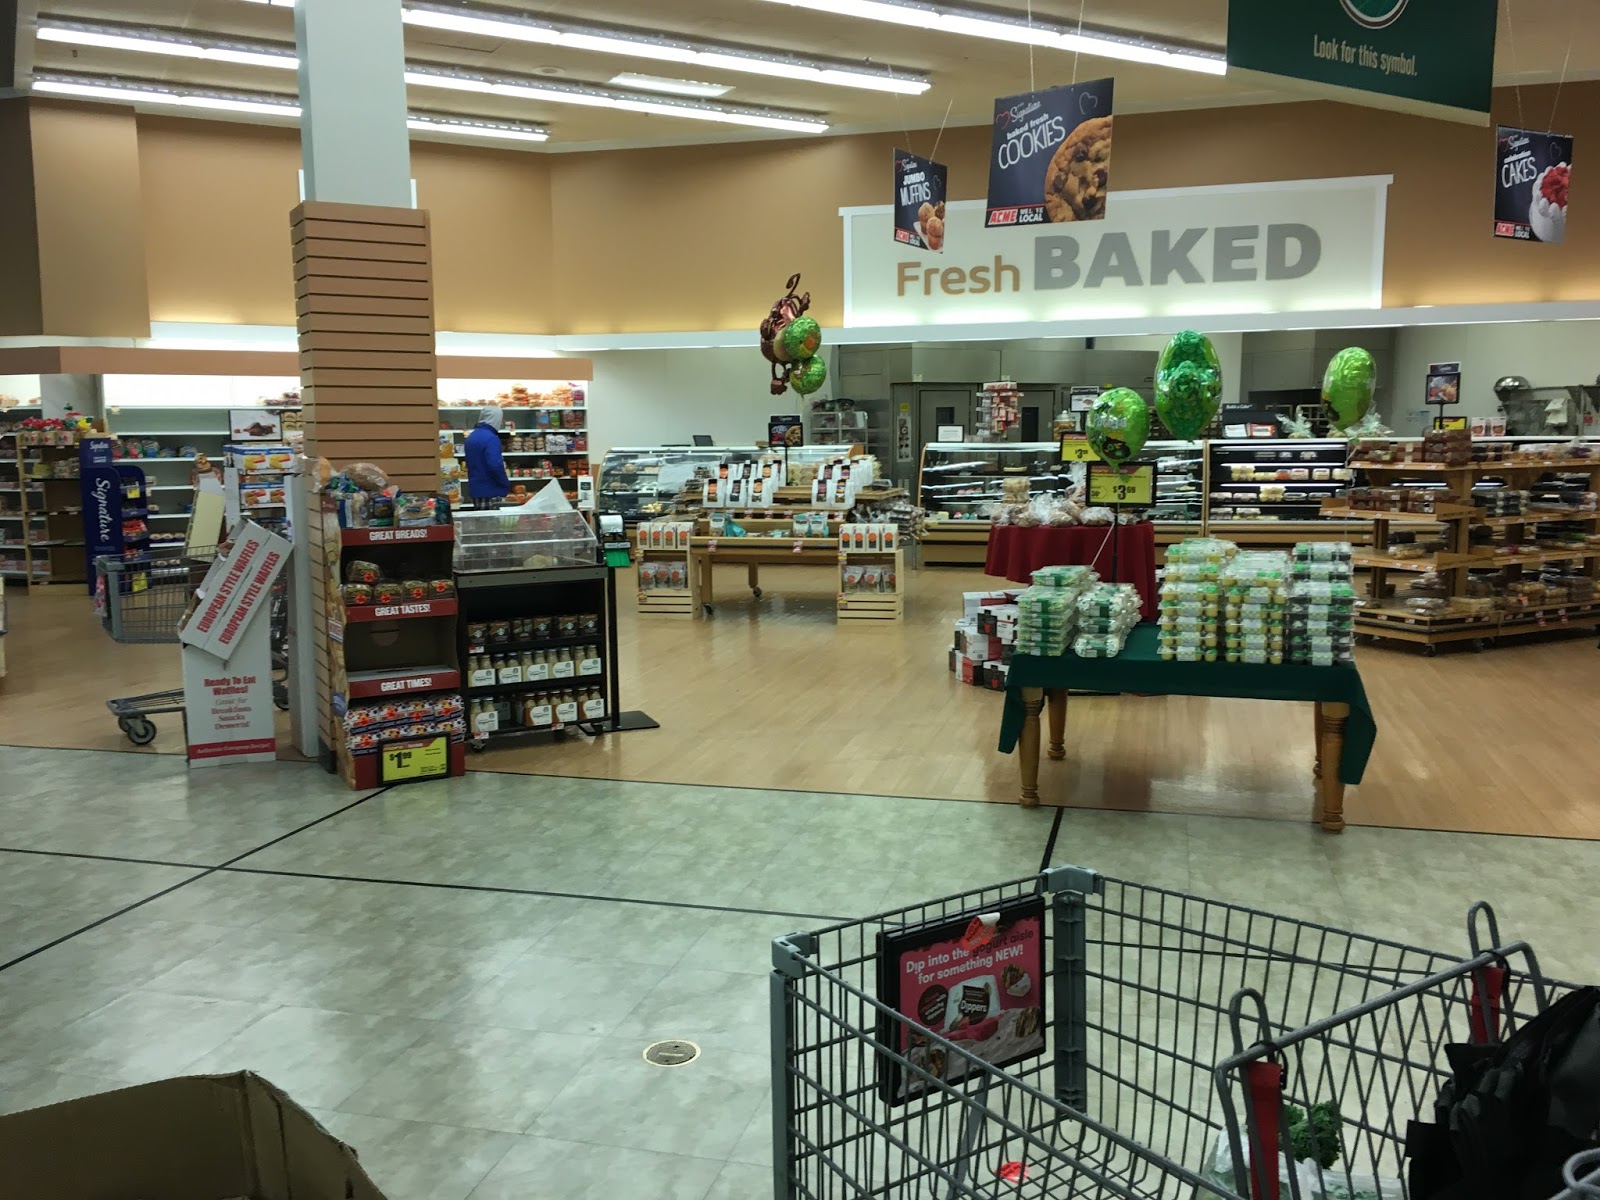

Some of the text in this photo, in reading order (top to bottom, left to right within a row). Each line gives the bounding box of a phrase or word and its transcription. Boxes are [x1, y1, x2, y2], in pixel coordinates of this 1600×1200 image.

[1313, 34, 1418, 77] Look for this symbol.
[998, 116, 1066, 169] COOKIES
[1501, 156, 1538, 188] CAKES
[899, 181, 932, 207] MUFFINS
[990, 210, 1017, 224] ACME
[1019, 213, 1044, 223] LOCAL
[897, 222, 1322, 297] Fresh BAKED
[91, 477, 113, 542] Signature
[369, 529, 428, 541] GREAT BREADS!
[196, 539, 260, 633] EUROPEAN STYLE WAFFLES
[218, 551, 280, 645] EUROPEAN STYLE WAFFLES
[375, 604, 431, 617] GREAT TASTES!
[204, 678, 231, 687] Ready
[243, 676, 256, 685] Eat
[380, 678, 432, 692] GREAT TIMES!
[906, 929, 1034, 974] Dip into the yogurt aisle
[917, 944, 1024, 985] for something NEW!
[959, 1000, 988, 1013] Dippers
